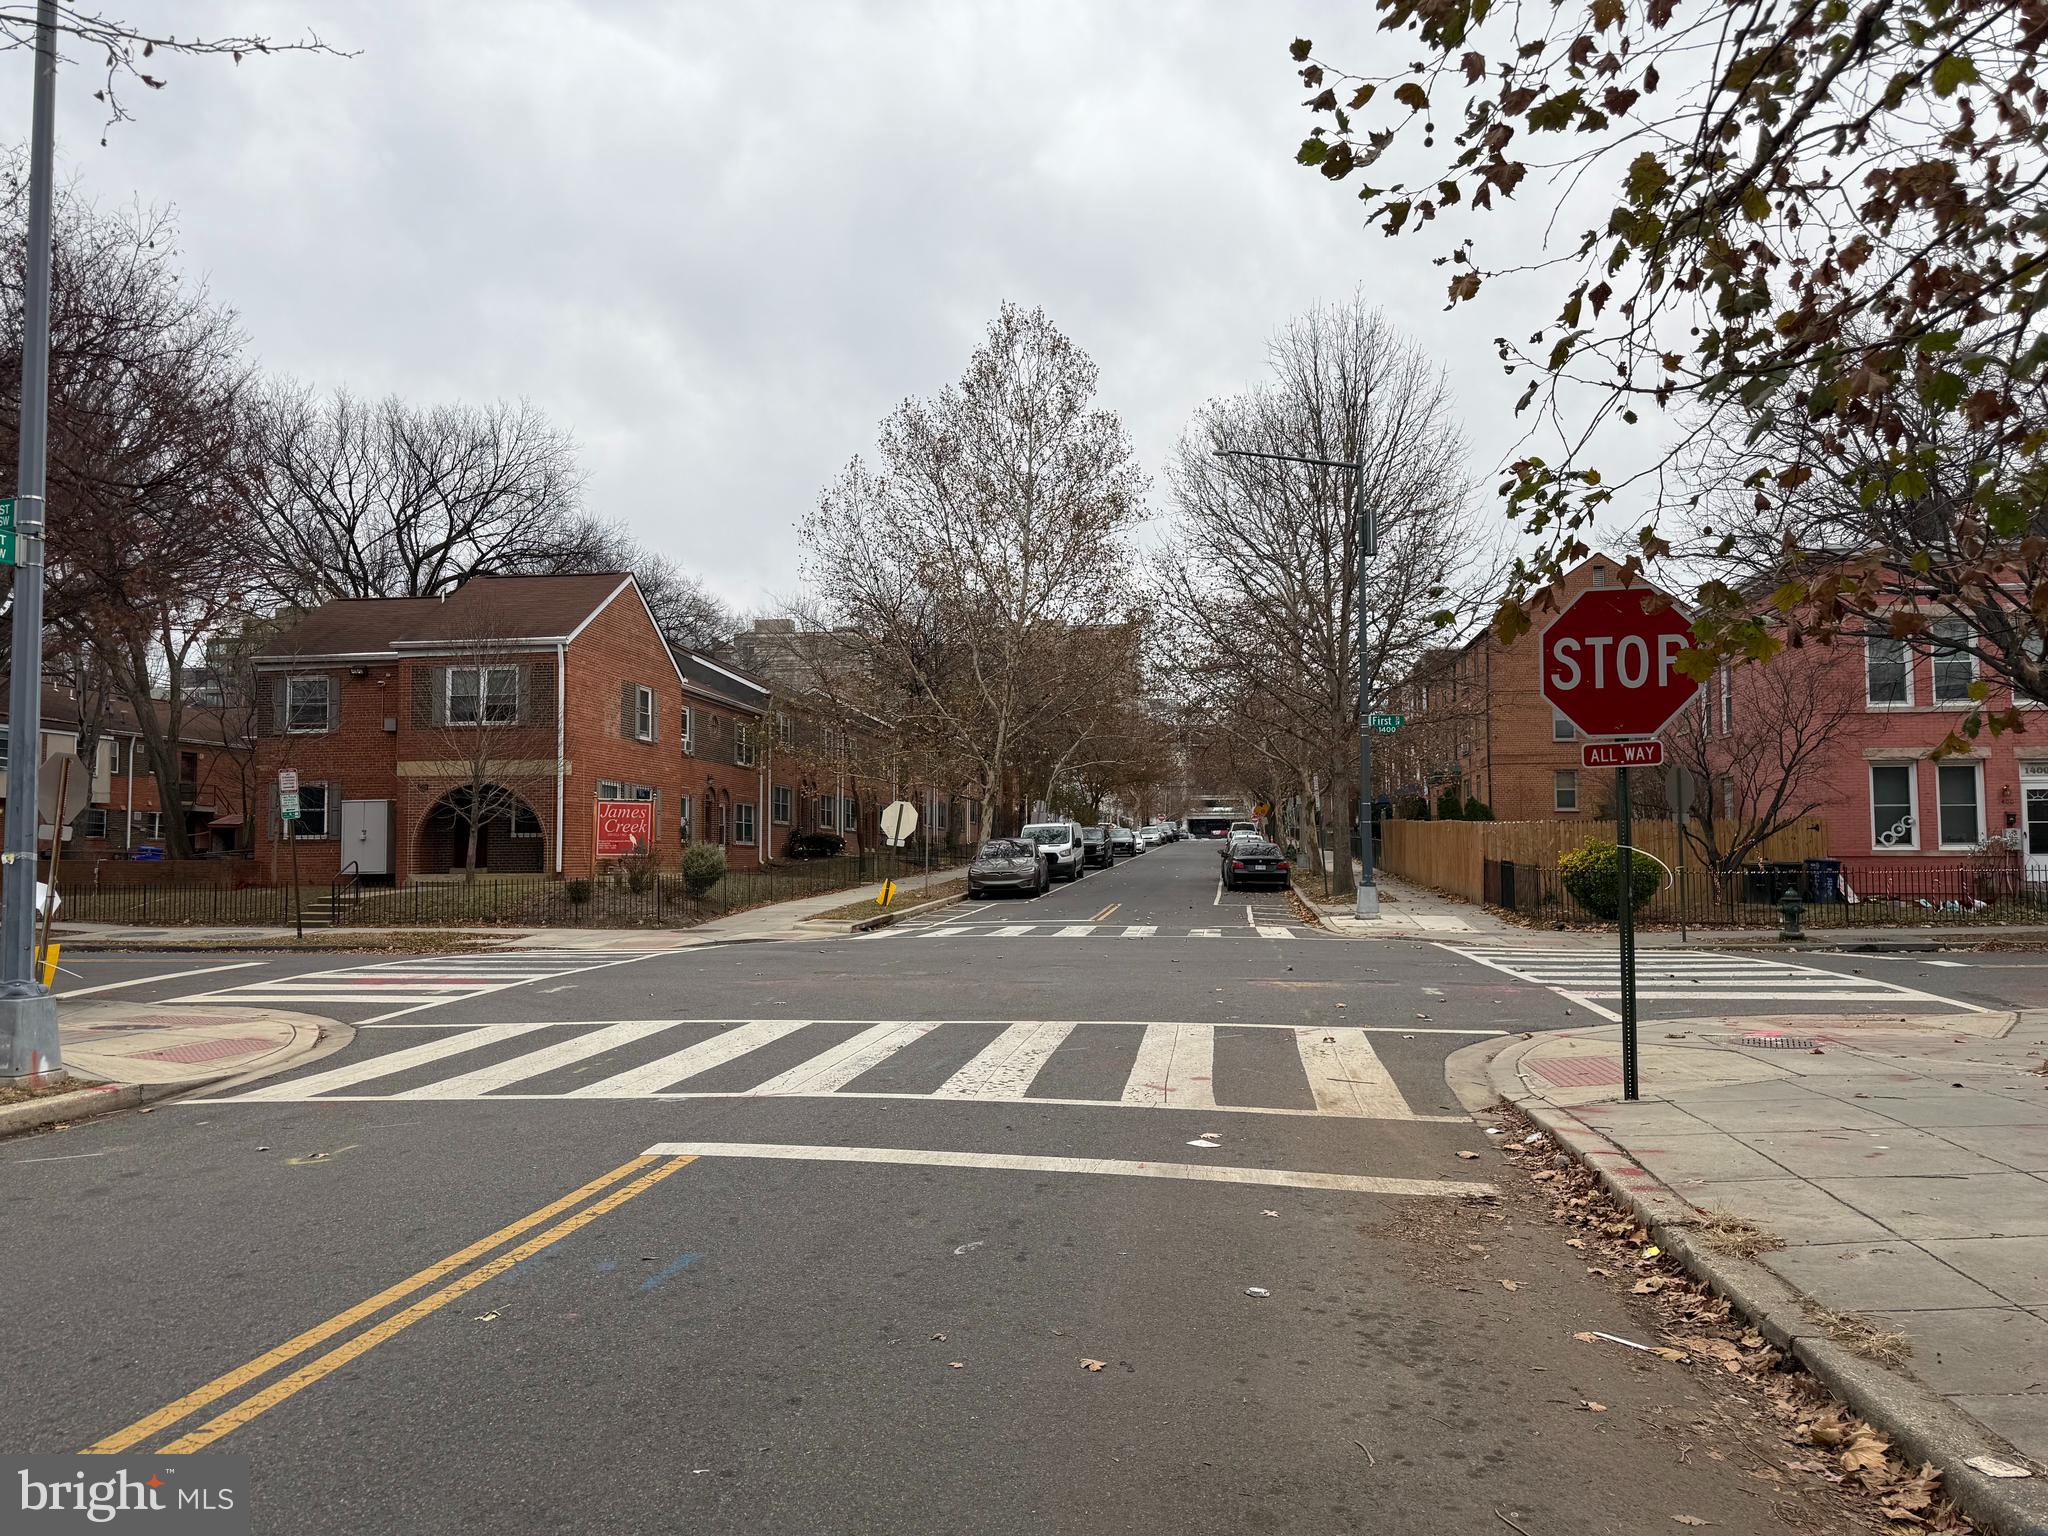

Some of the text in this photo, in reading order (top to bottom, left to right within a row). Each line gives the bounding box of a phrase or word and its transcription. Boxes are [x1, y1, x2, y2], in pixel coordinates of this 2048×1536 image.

[1550, 634, 1690, 691] STOP
[1372, 716, 1392, 726] First
[1590, 746, 1654, 763] ALL WAY
[600, 805, 647, 818] James
[604, 818, 648, 833] Creek
